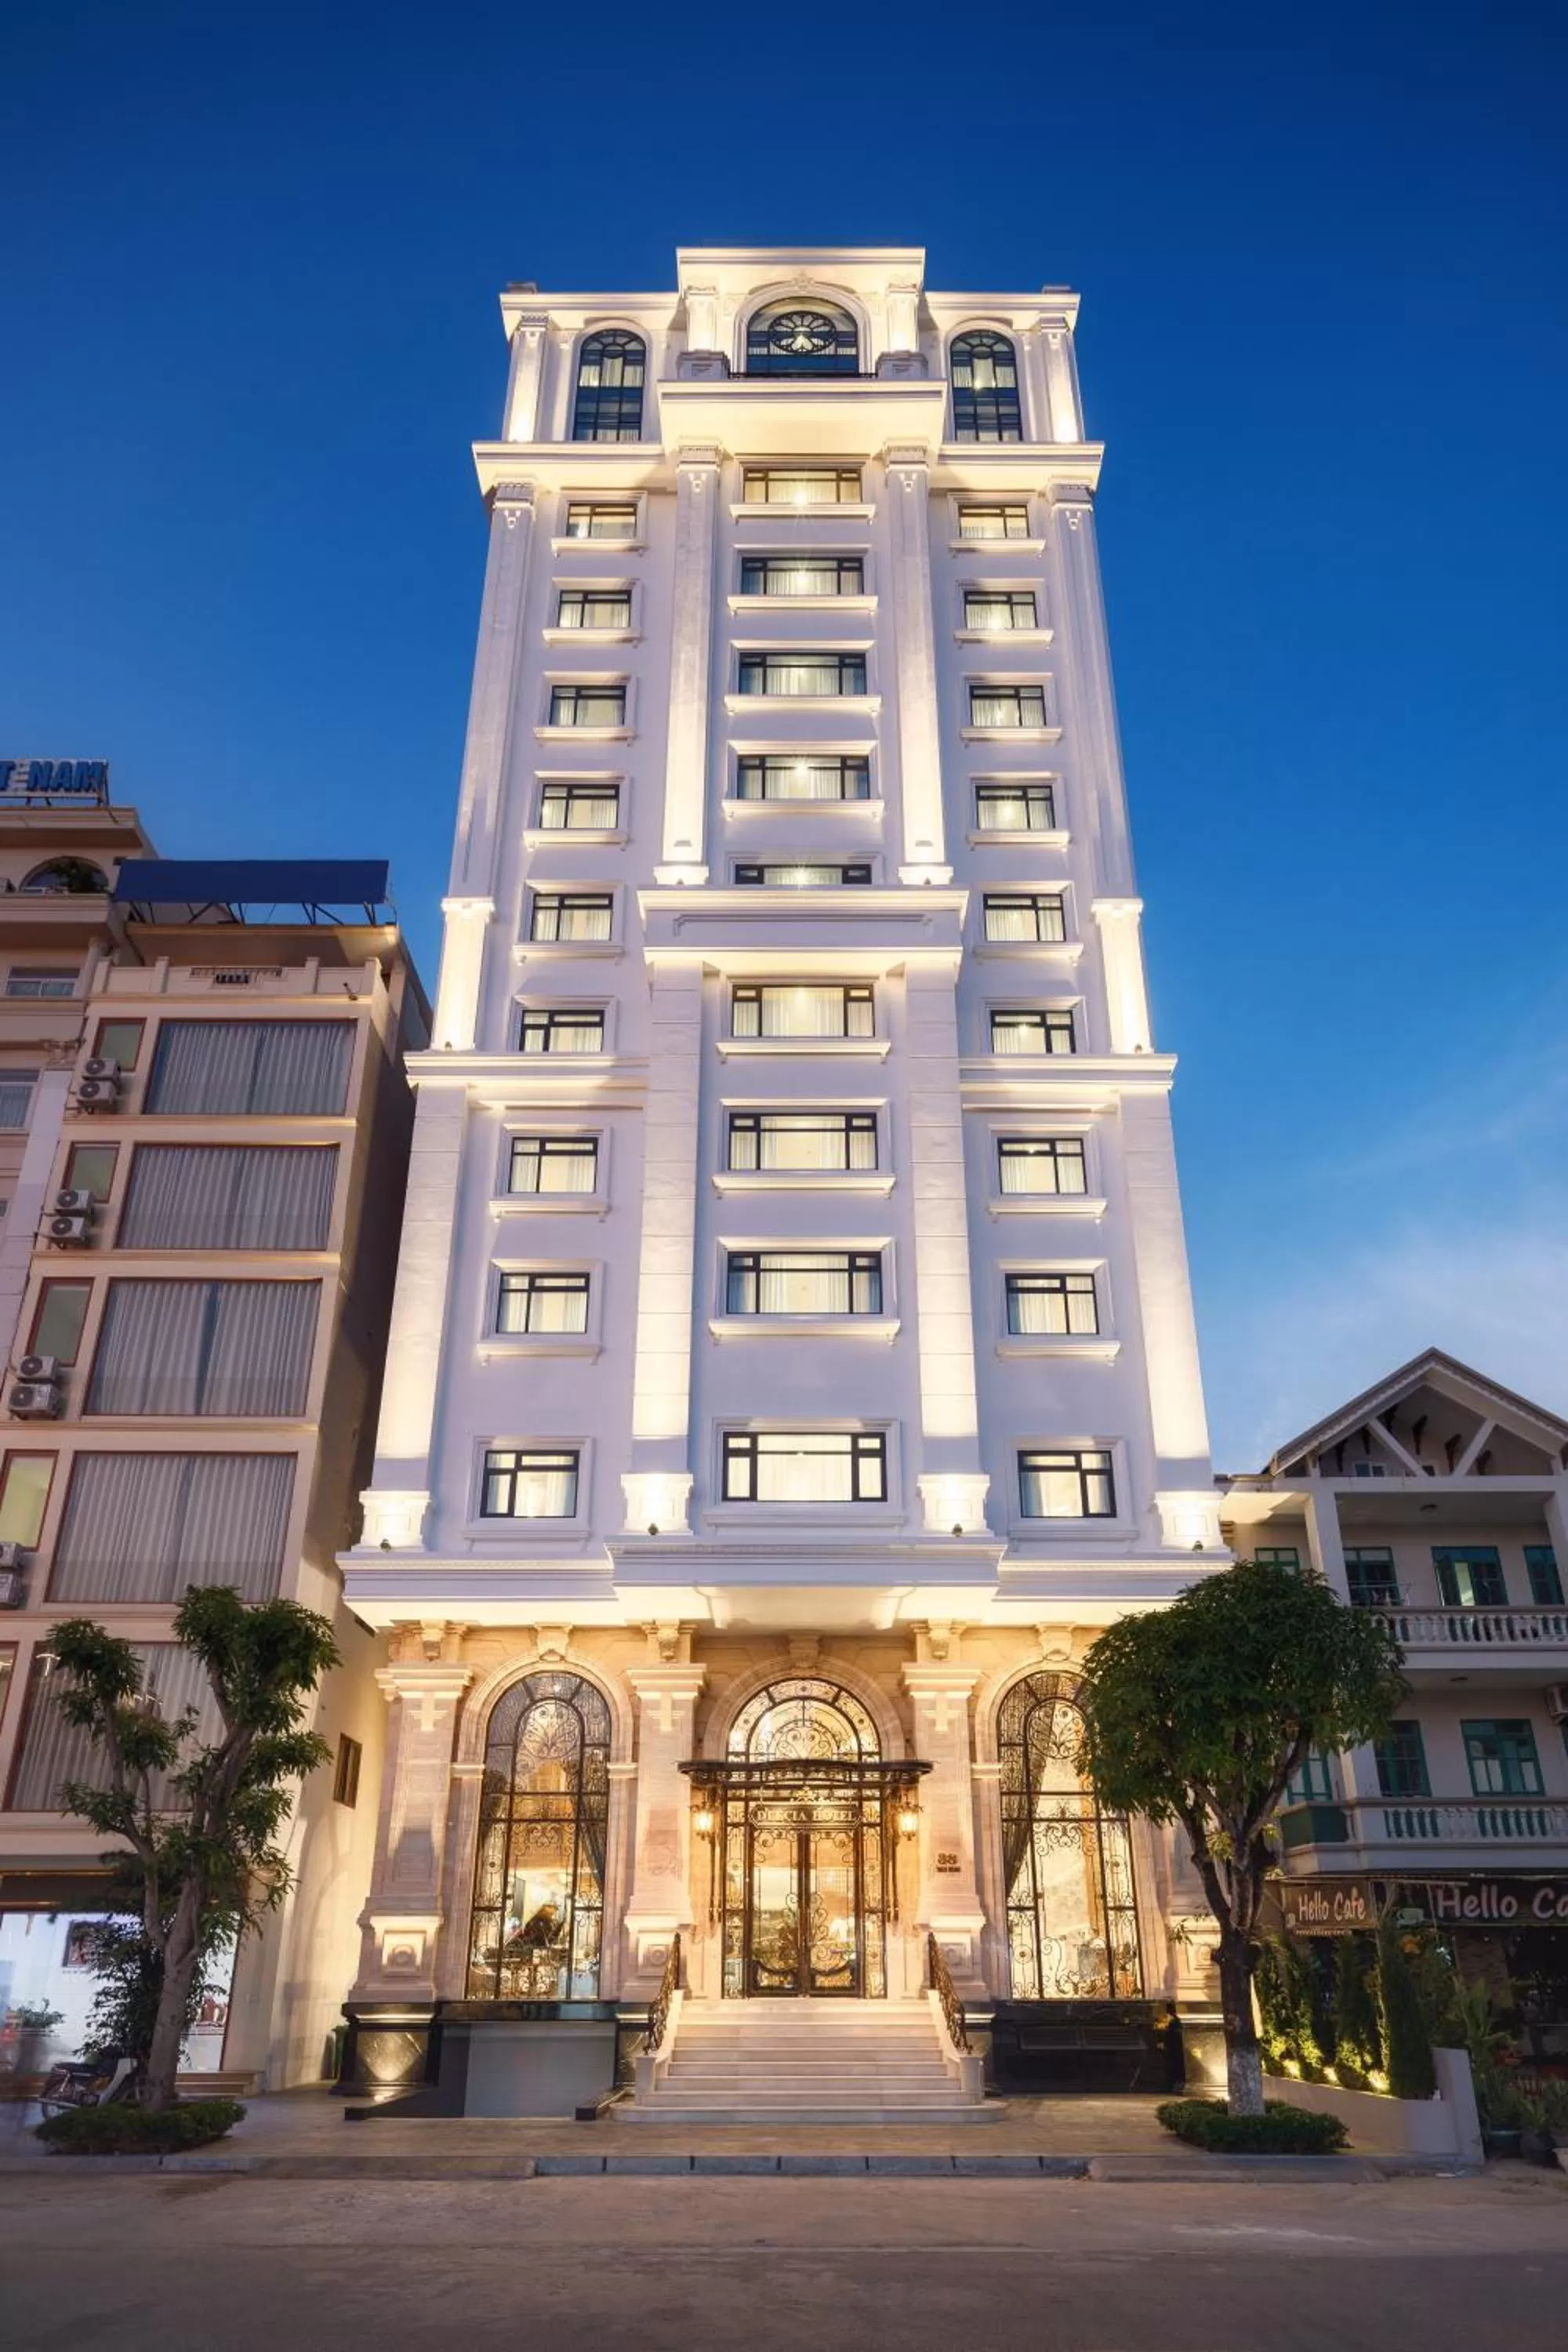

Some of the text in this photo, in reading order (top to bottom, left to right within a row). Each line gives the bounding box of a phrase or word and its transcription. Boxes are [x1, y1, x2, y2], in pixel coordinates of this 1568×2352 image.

[27, 760, 105, 792] NAM
[812, 1809, 855, 1821] HOTEL
[1298, 1886, 1366, 1922] Hello Cafe
[1437, 1884, 1518, 1919] Hello
